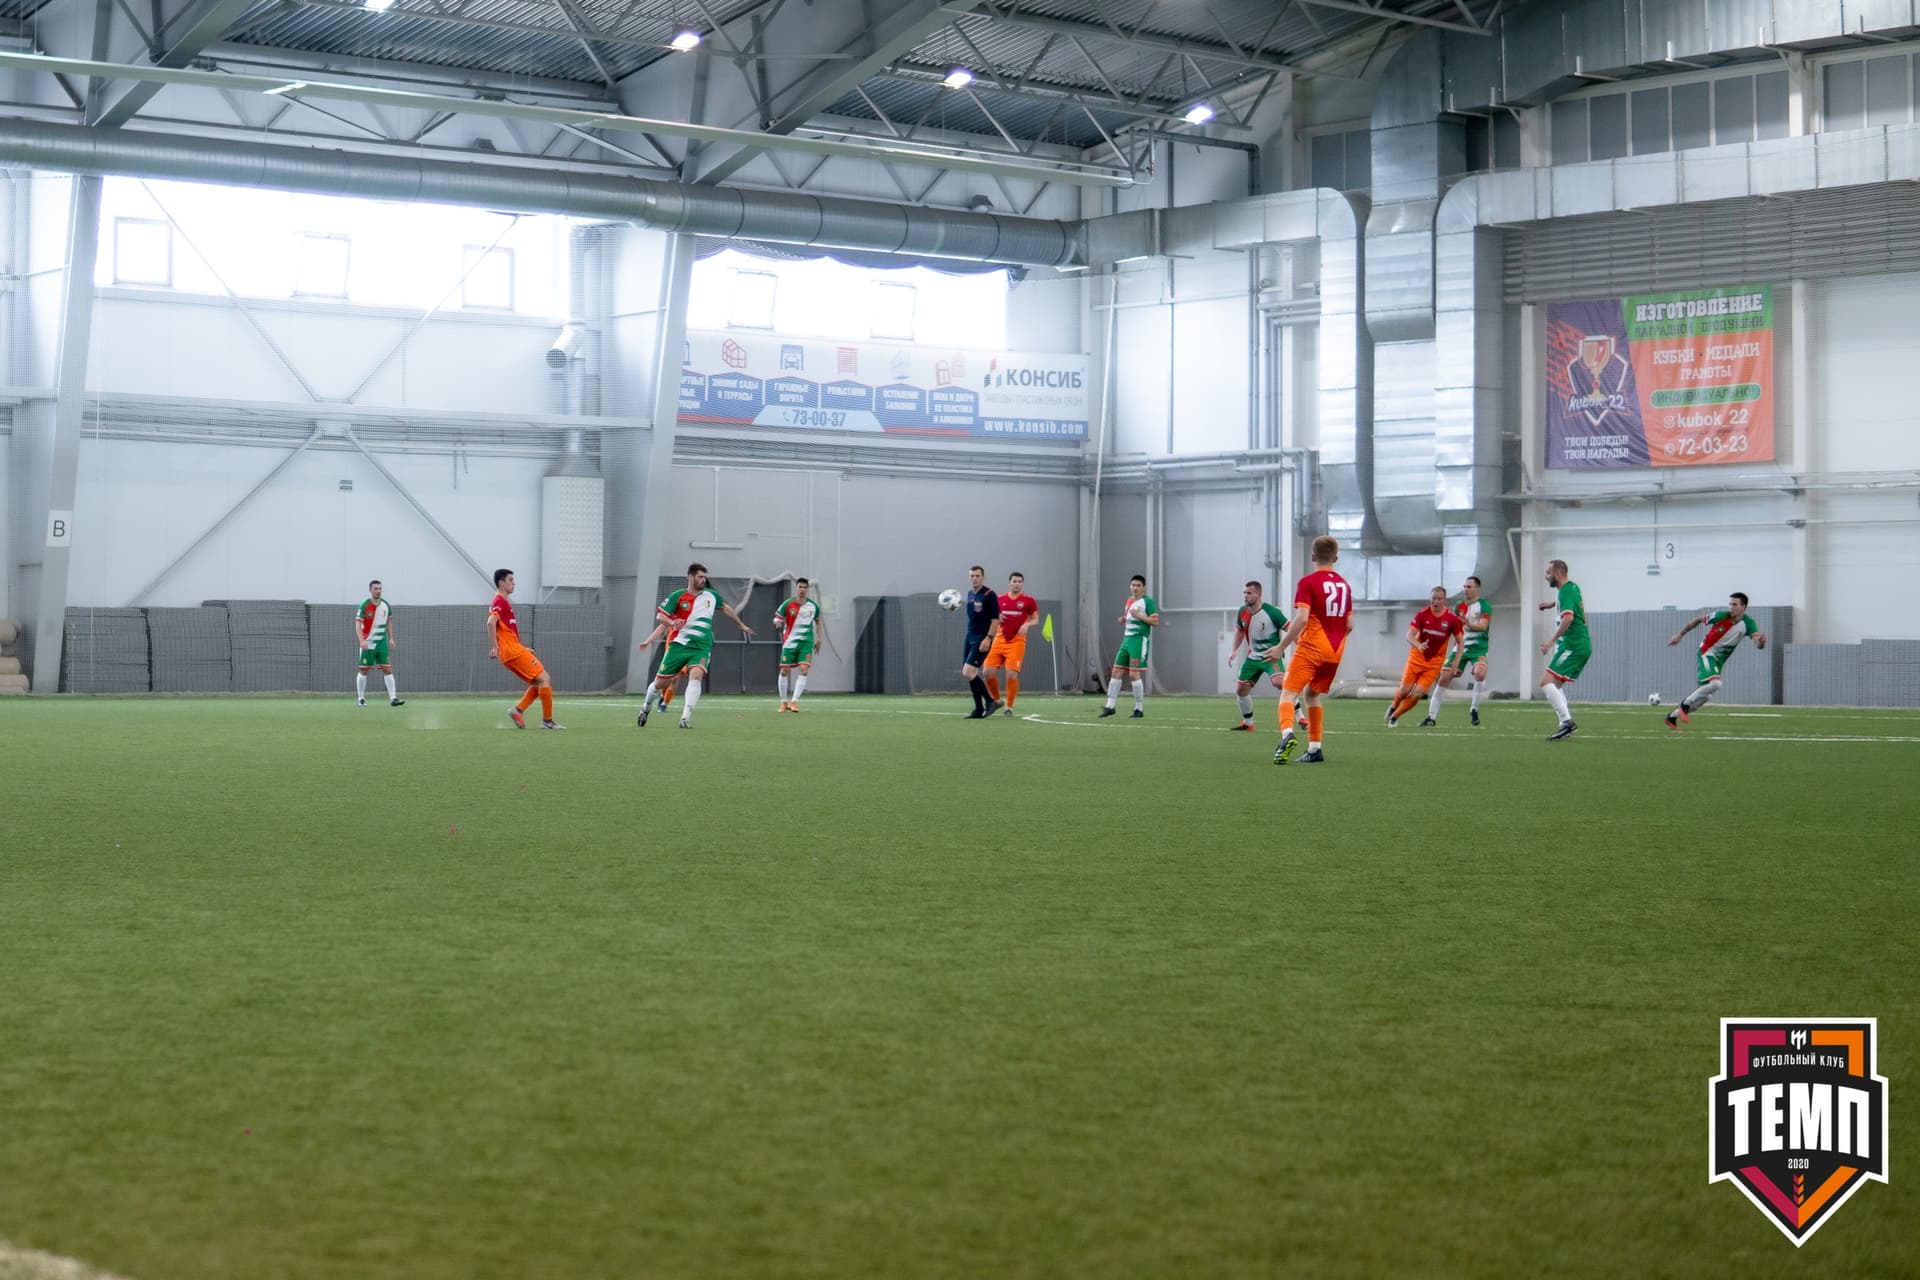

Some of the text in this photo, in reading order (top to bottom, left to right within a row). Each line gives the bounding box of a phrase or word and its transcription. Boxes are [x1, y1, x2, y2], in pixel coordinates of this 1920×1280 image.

[1635, 293, 1763, 322] ИЗГОТОВЛЕНИЕ
[1653, 342, 1761, 365] КУБКИ МЕДАЛИ
[1006, 368, 1082, 389] КОНСИБ
[1680, 365, 1732, 380] ГРАМОТЫ
[792, 409, 847, 427] 73-00-37
[984, 419, 1084, 435] www.konsib.com
[1678, 407, 1749, 428] kubok_22
[1564, 436, 1587, 448] ТВОИ
[1678, 434, 1749, 456] 72-03-23
[1564, 448, 1587, 460] ТВОИ
[1665, 542, 1675, 560] 3
[1323, 581, 1347, 618] 27
